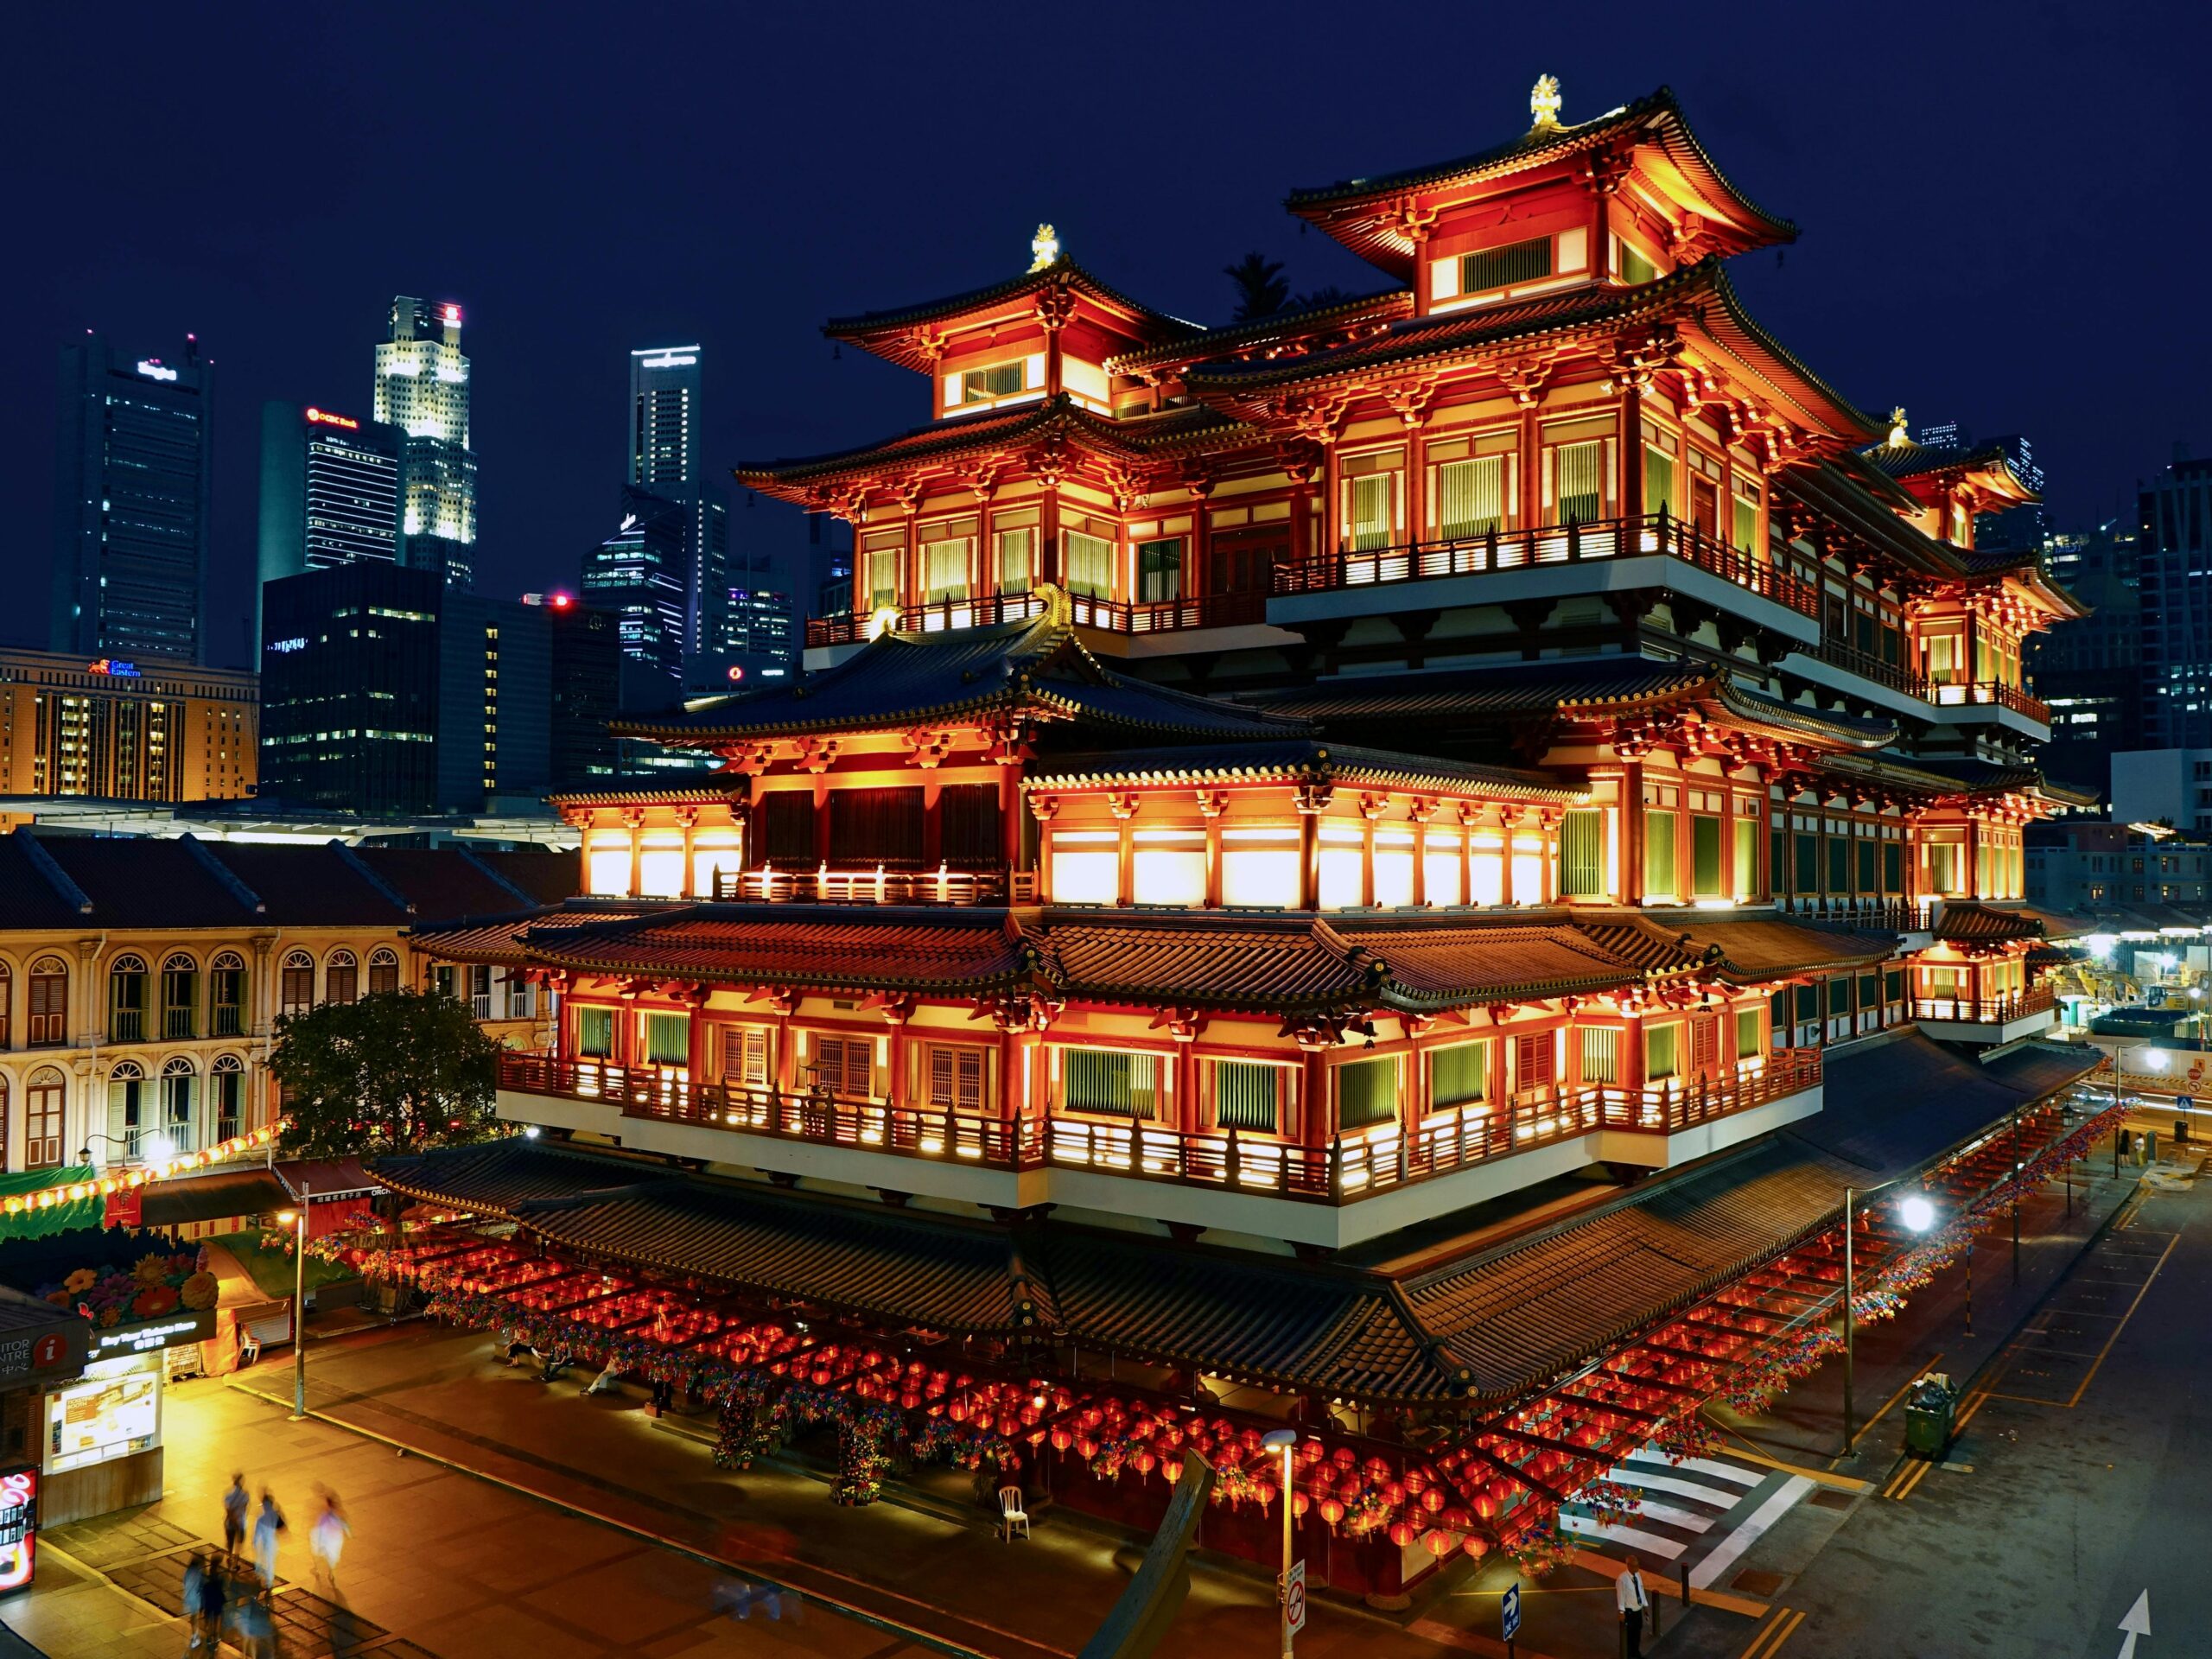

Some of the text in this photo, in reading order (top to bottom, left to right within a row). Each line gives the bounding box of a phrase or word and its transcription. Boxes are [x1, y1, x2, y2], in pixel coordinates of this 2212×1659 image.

[319, 413, 358, 428] OCBC Bank
[111, 659, 134, 670] Great
[111, 668, 141, 677] Eastern
[67, 1402, 87, 1410] BOOTH
